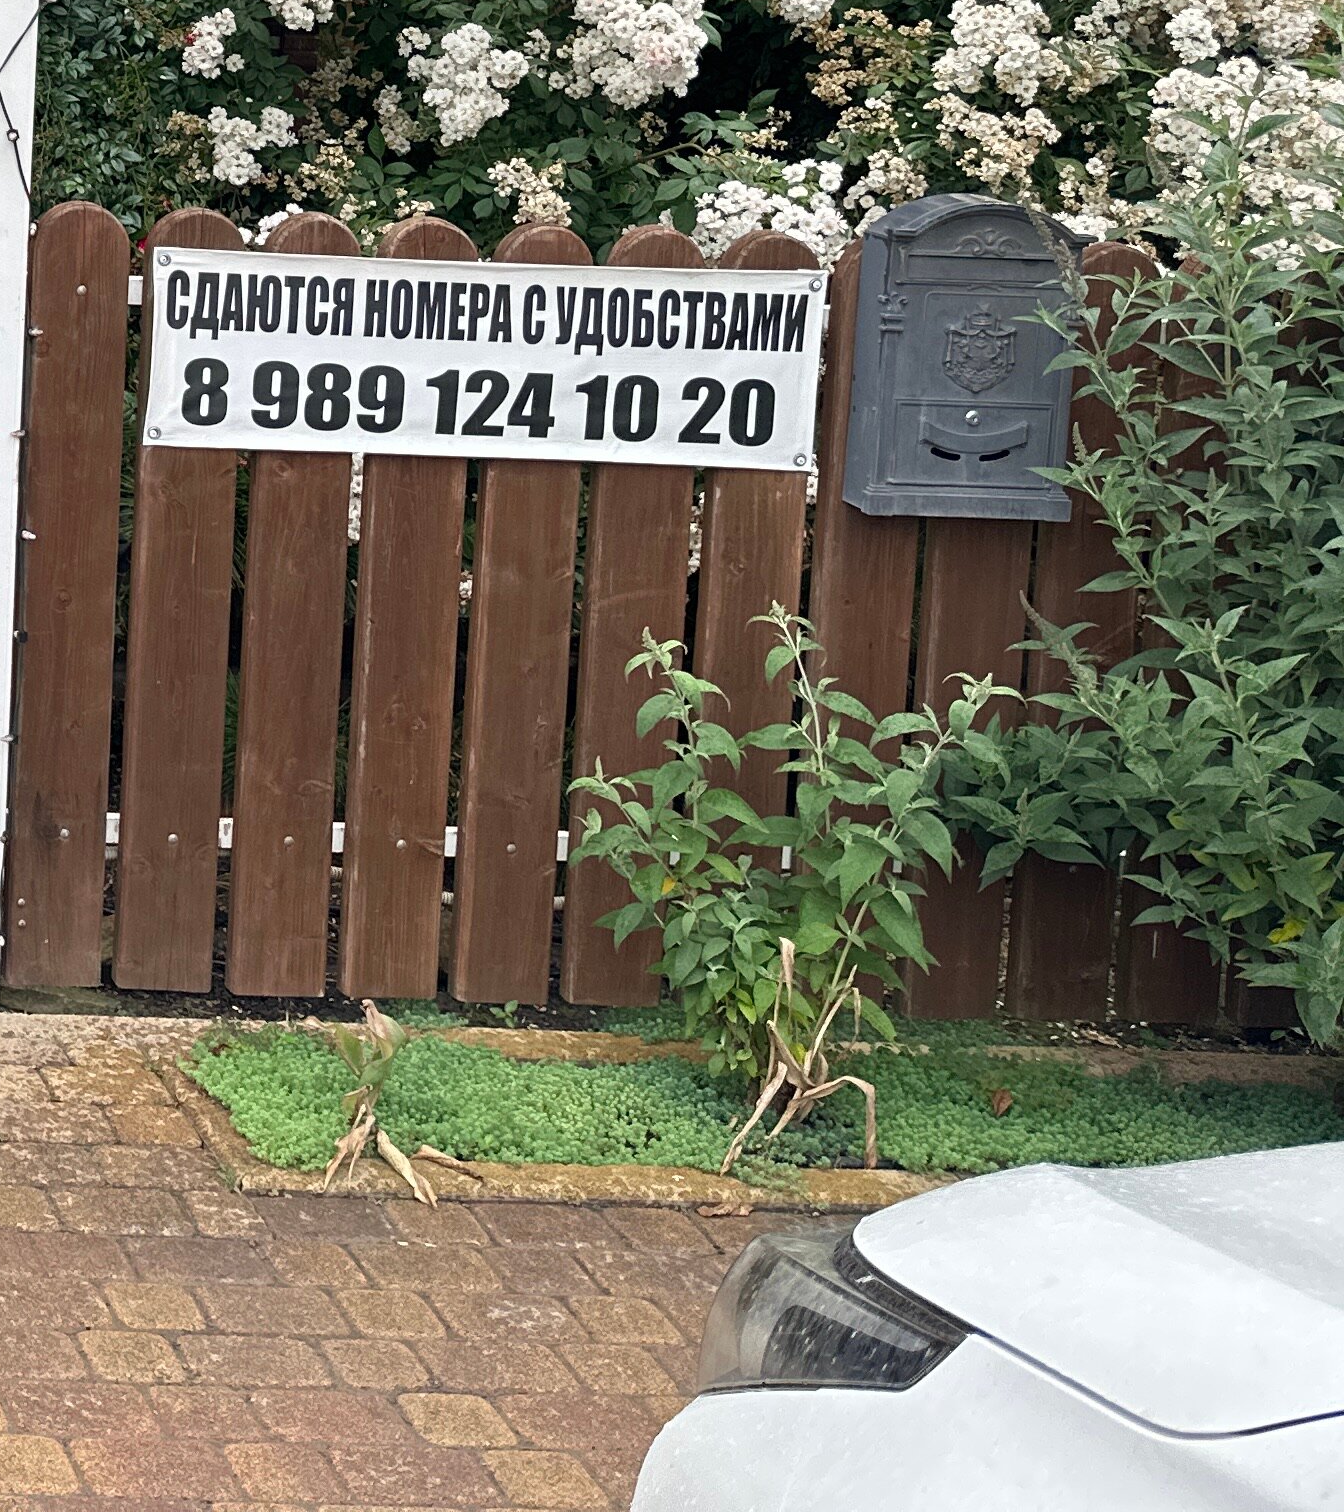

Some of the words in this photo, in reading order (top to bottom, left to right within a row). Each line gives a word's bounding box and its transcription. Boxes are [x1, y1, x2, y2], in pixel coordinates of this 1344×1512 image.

[165, 270, 356, 340] СДАЮТСЯ
[363, 278, 512, 343] НОМЕРА
[522, 284, 547, 345] С
[555, 285, 810, 356] УДОБСТВАМИ
[181, 357, 229, 426] 8
[250, 360, 405, 434] 989
[425, 369, 556, 439] 124
[575, 374, 660, 443] 10
[677, 376, 776, 447] 20
